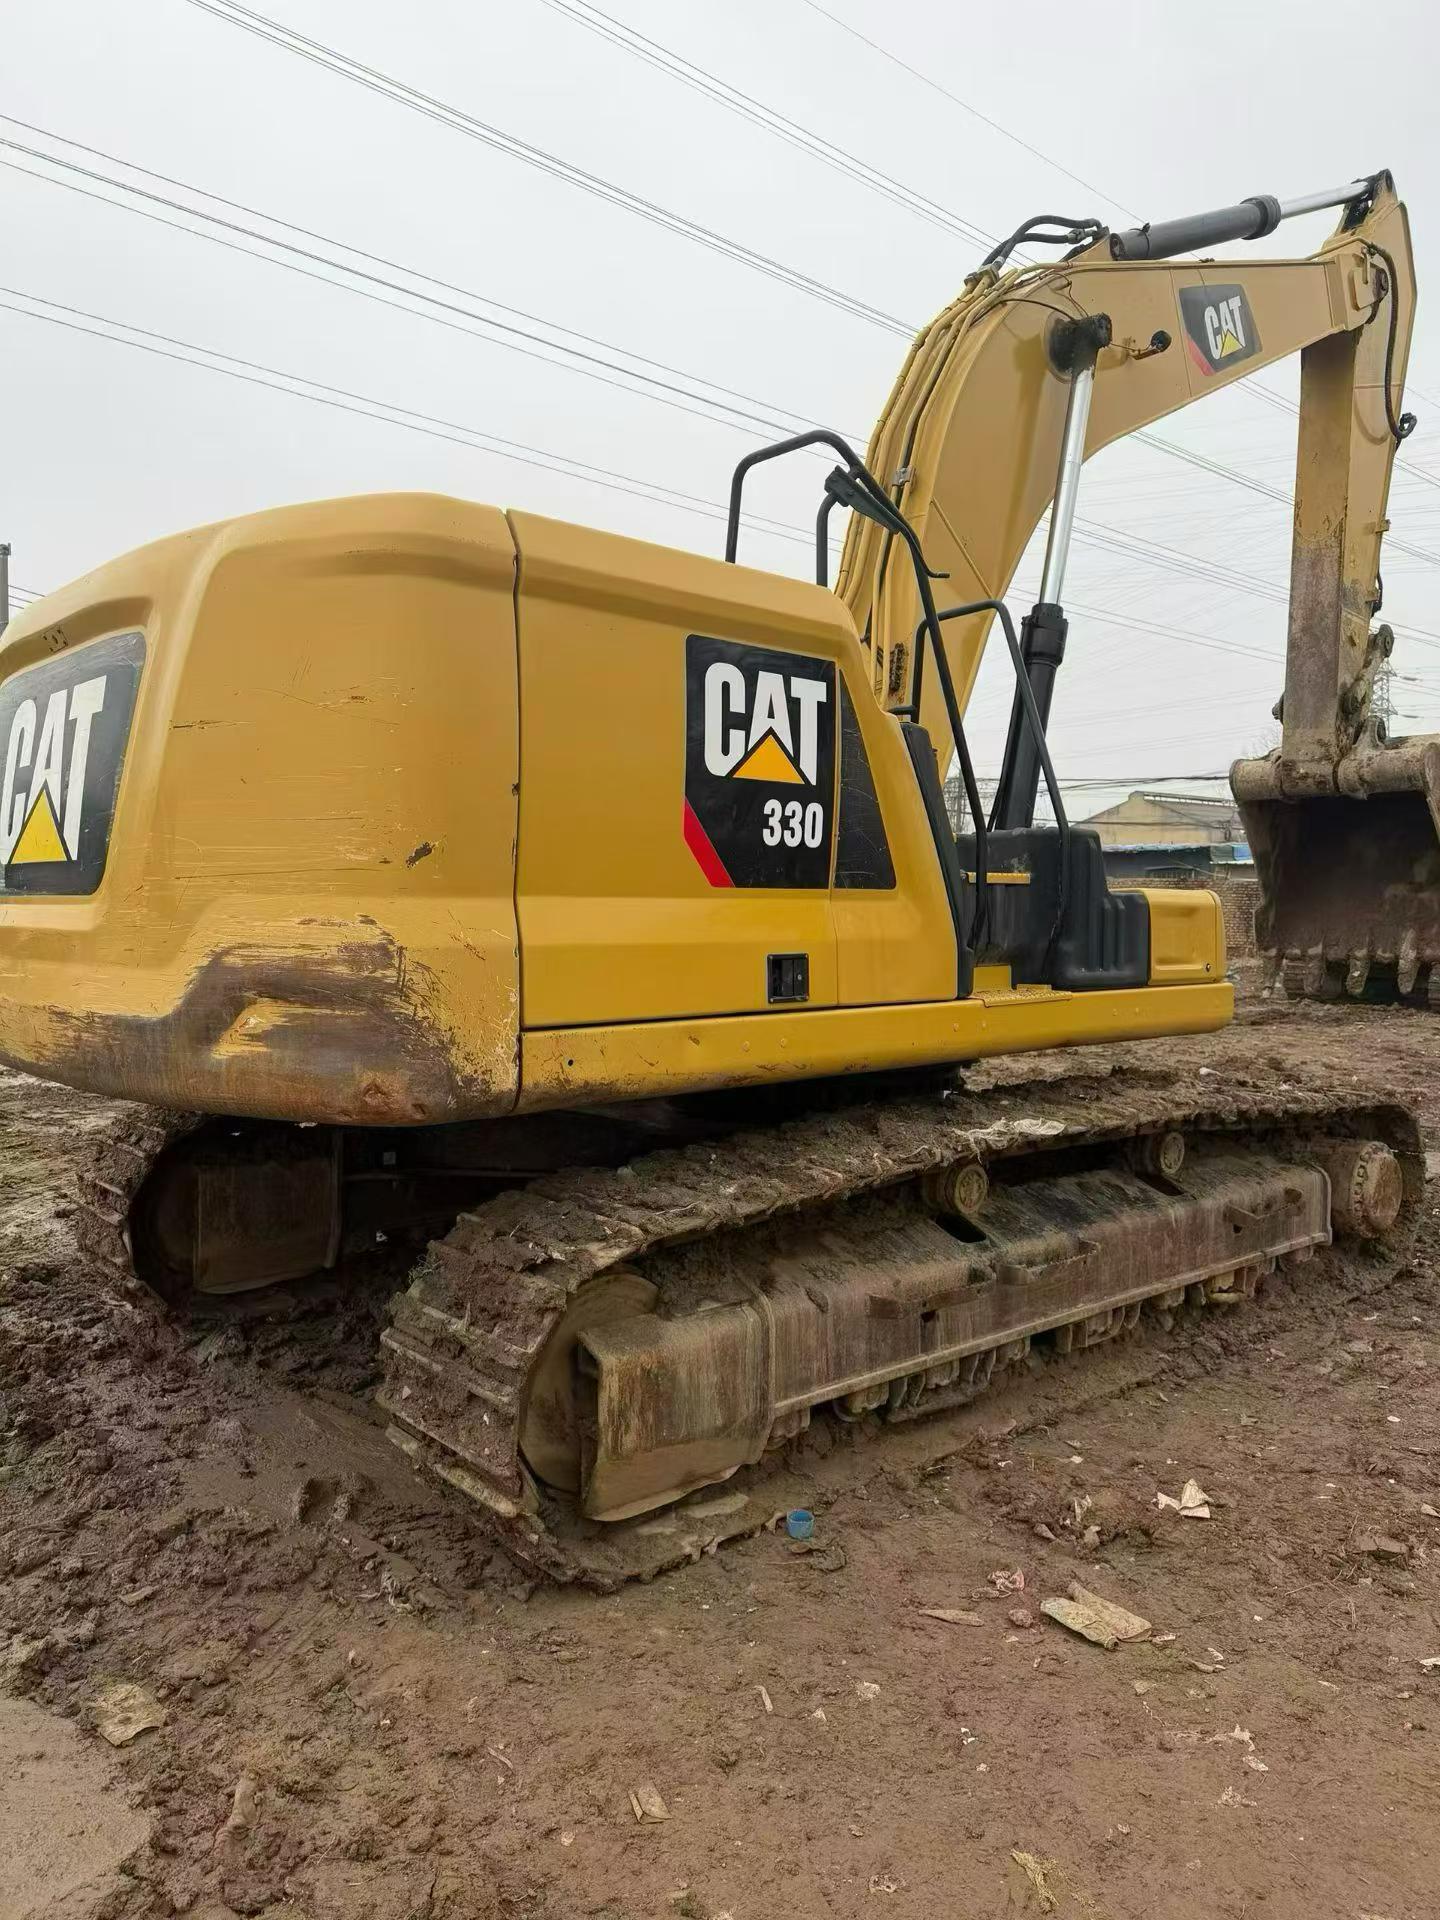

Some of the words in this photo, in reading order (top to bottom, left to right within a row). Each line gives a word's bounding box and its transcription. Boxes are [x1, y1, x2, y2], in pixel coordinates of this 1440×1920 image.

[1204, 295, 1247, 361] CAT
[0, 675, 107, 865] CAT
[704, 662, 827, 786] CAT
[763, 799, 824, 849] 330
